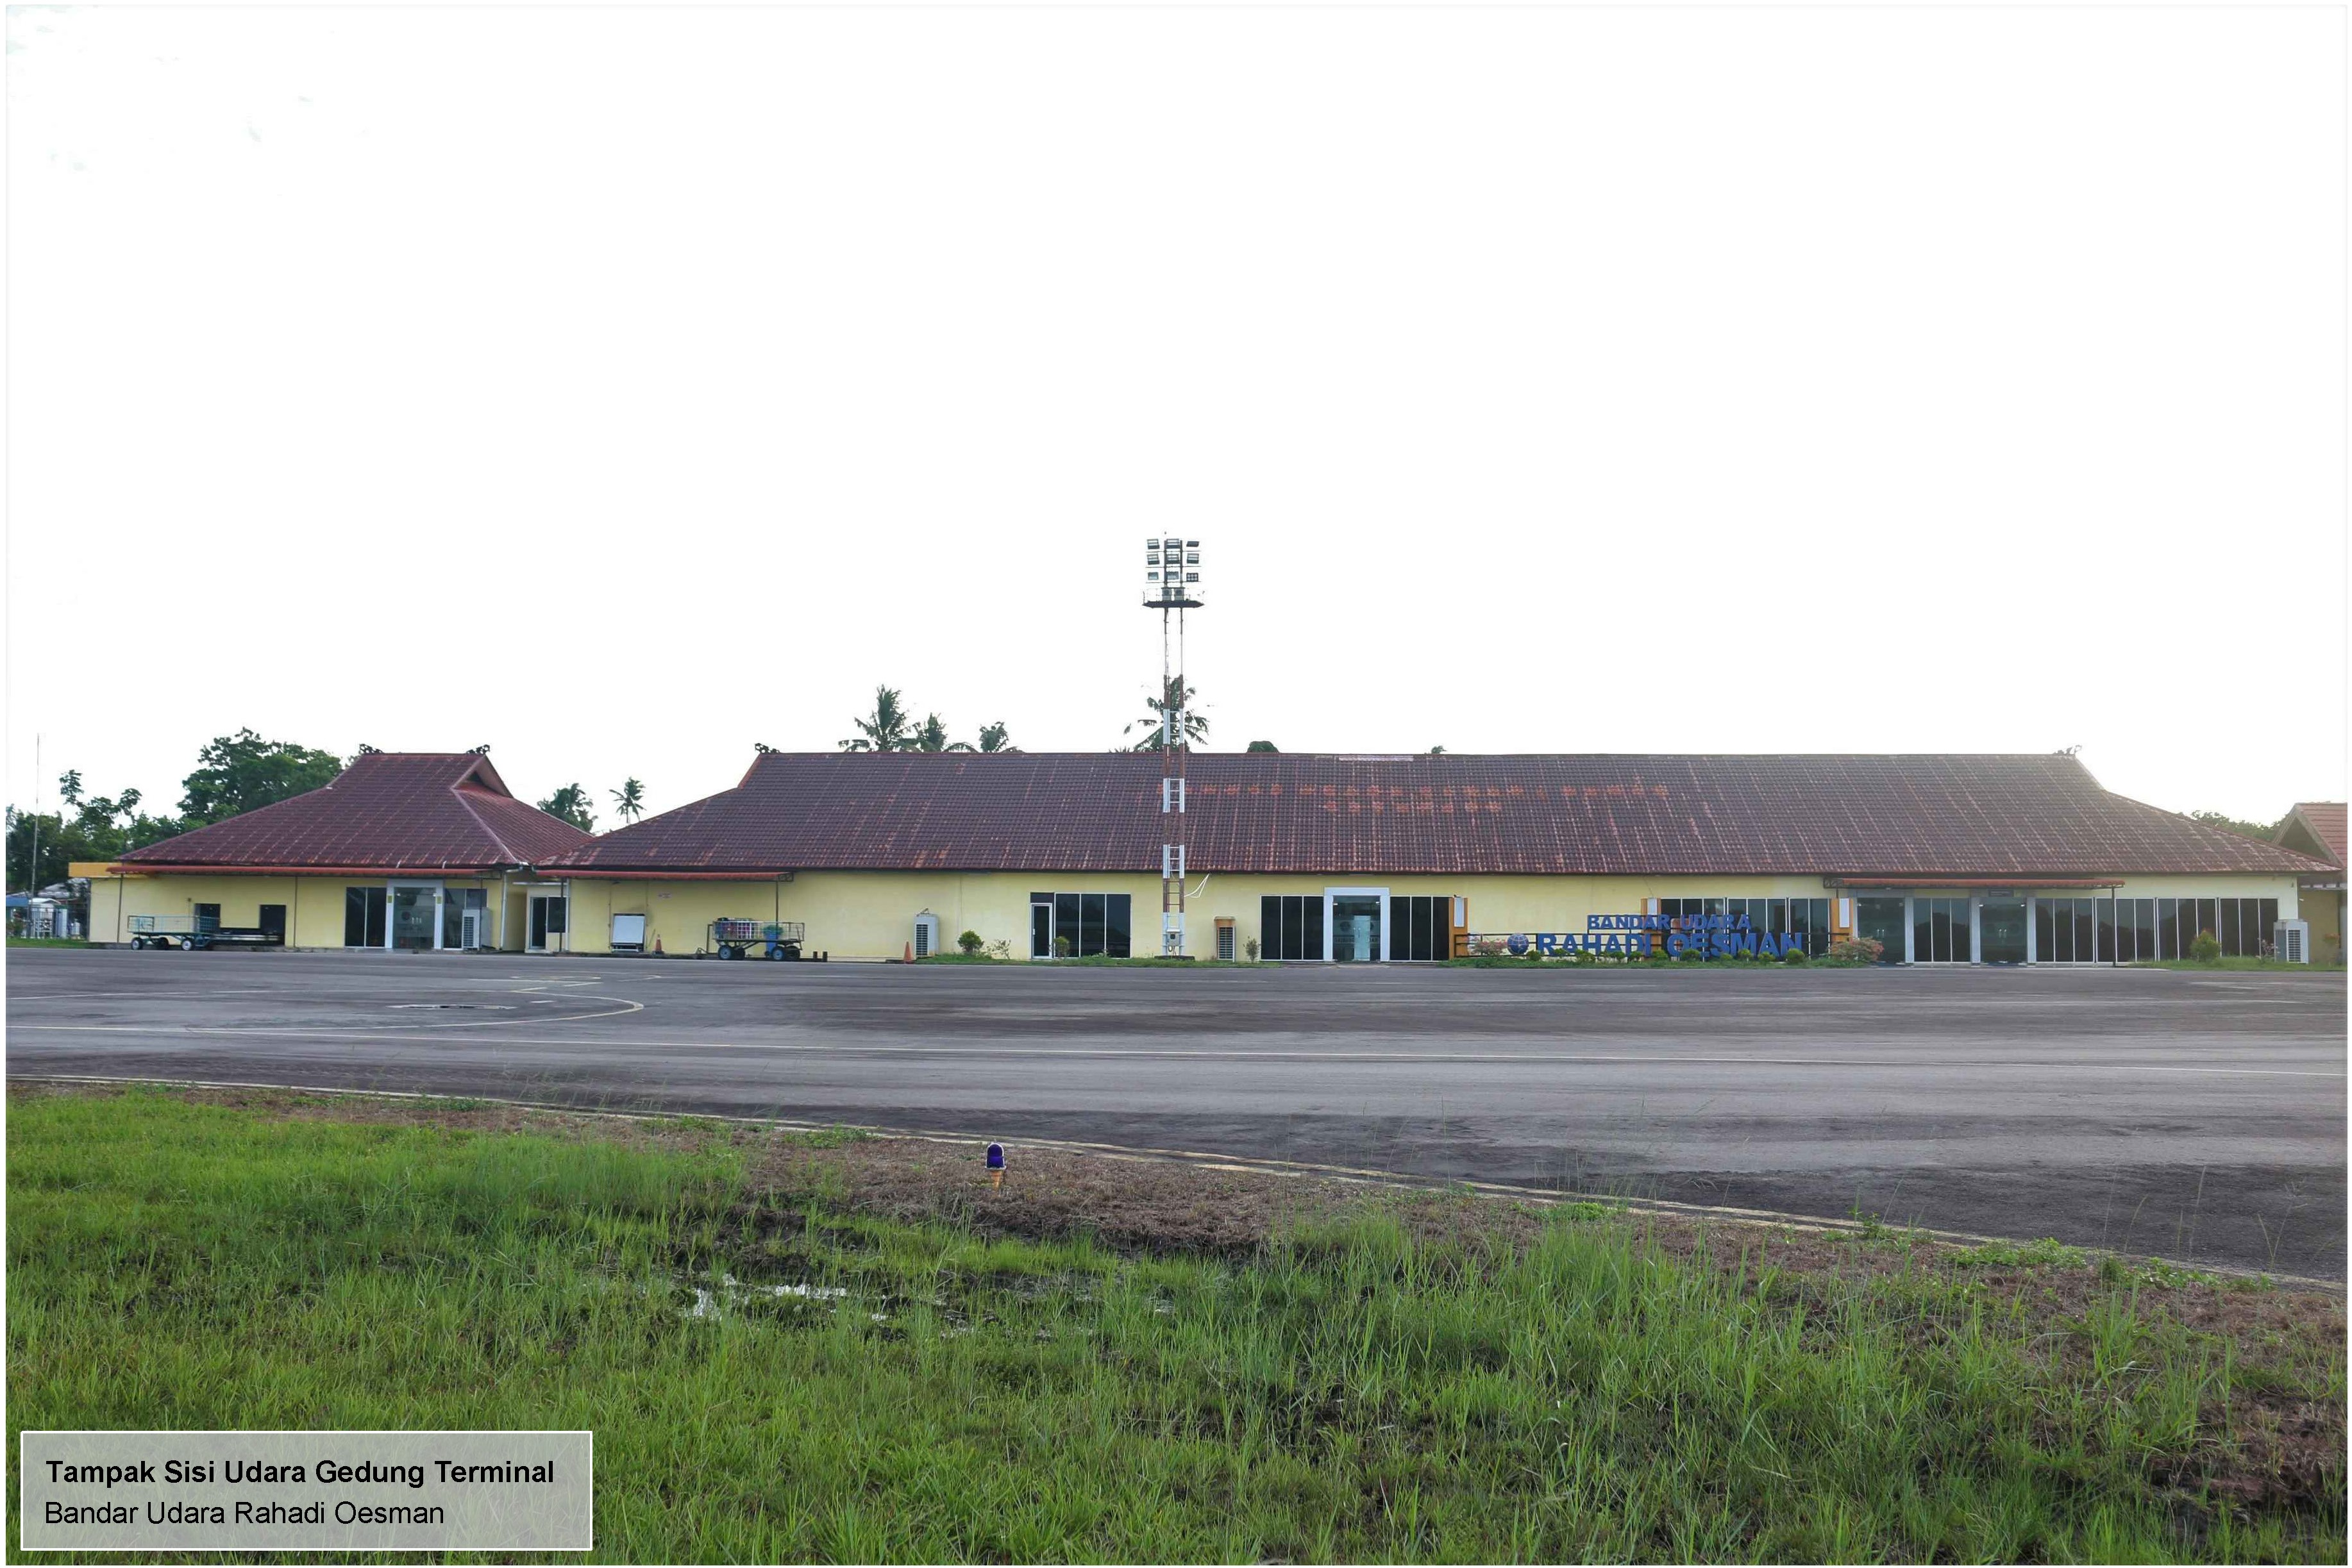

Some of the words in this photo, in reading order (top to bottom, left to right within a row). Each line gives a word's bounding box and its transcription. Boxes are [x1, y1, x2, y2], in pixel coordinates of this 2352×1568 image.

[1587, 914, 1670, 930] BANDAR
[1679, 914, 1751, 930] UDARA
[1538, 933, 1651, 958] RAHADI
[1667, 933, 1802, 958] OESMAN
